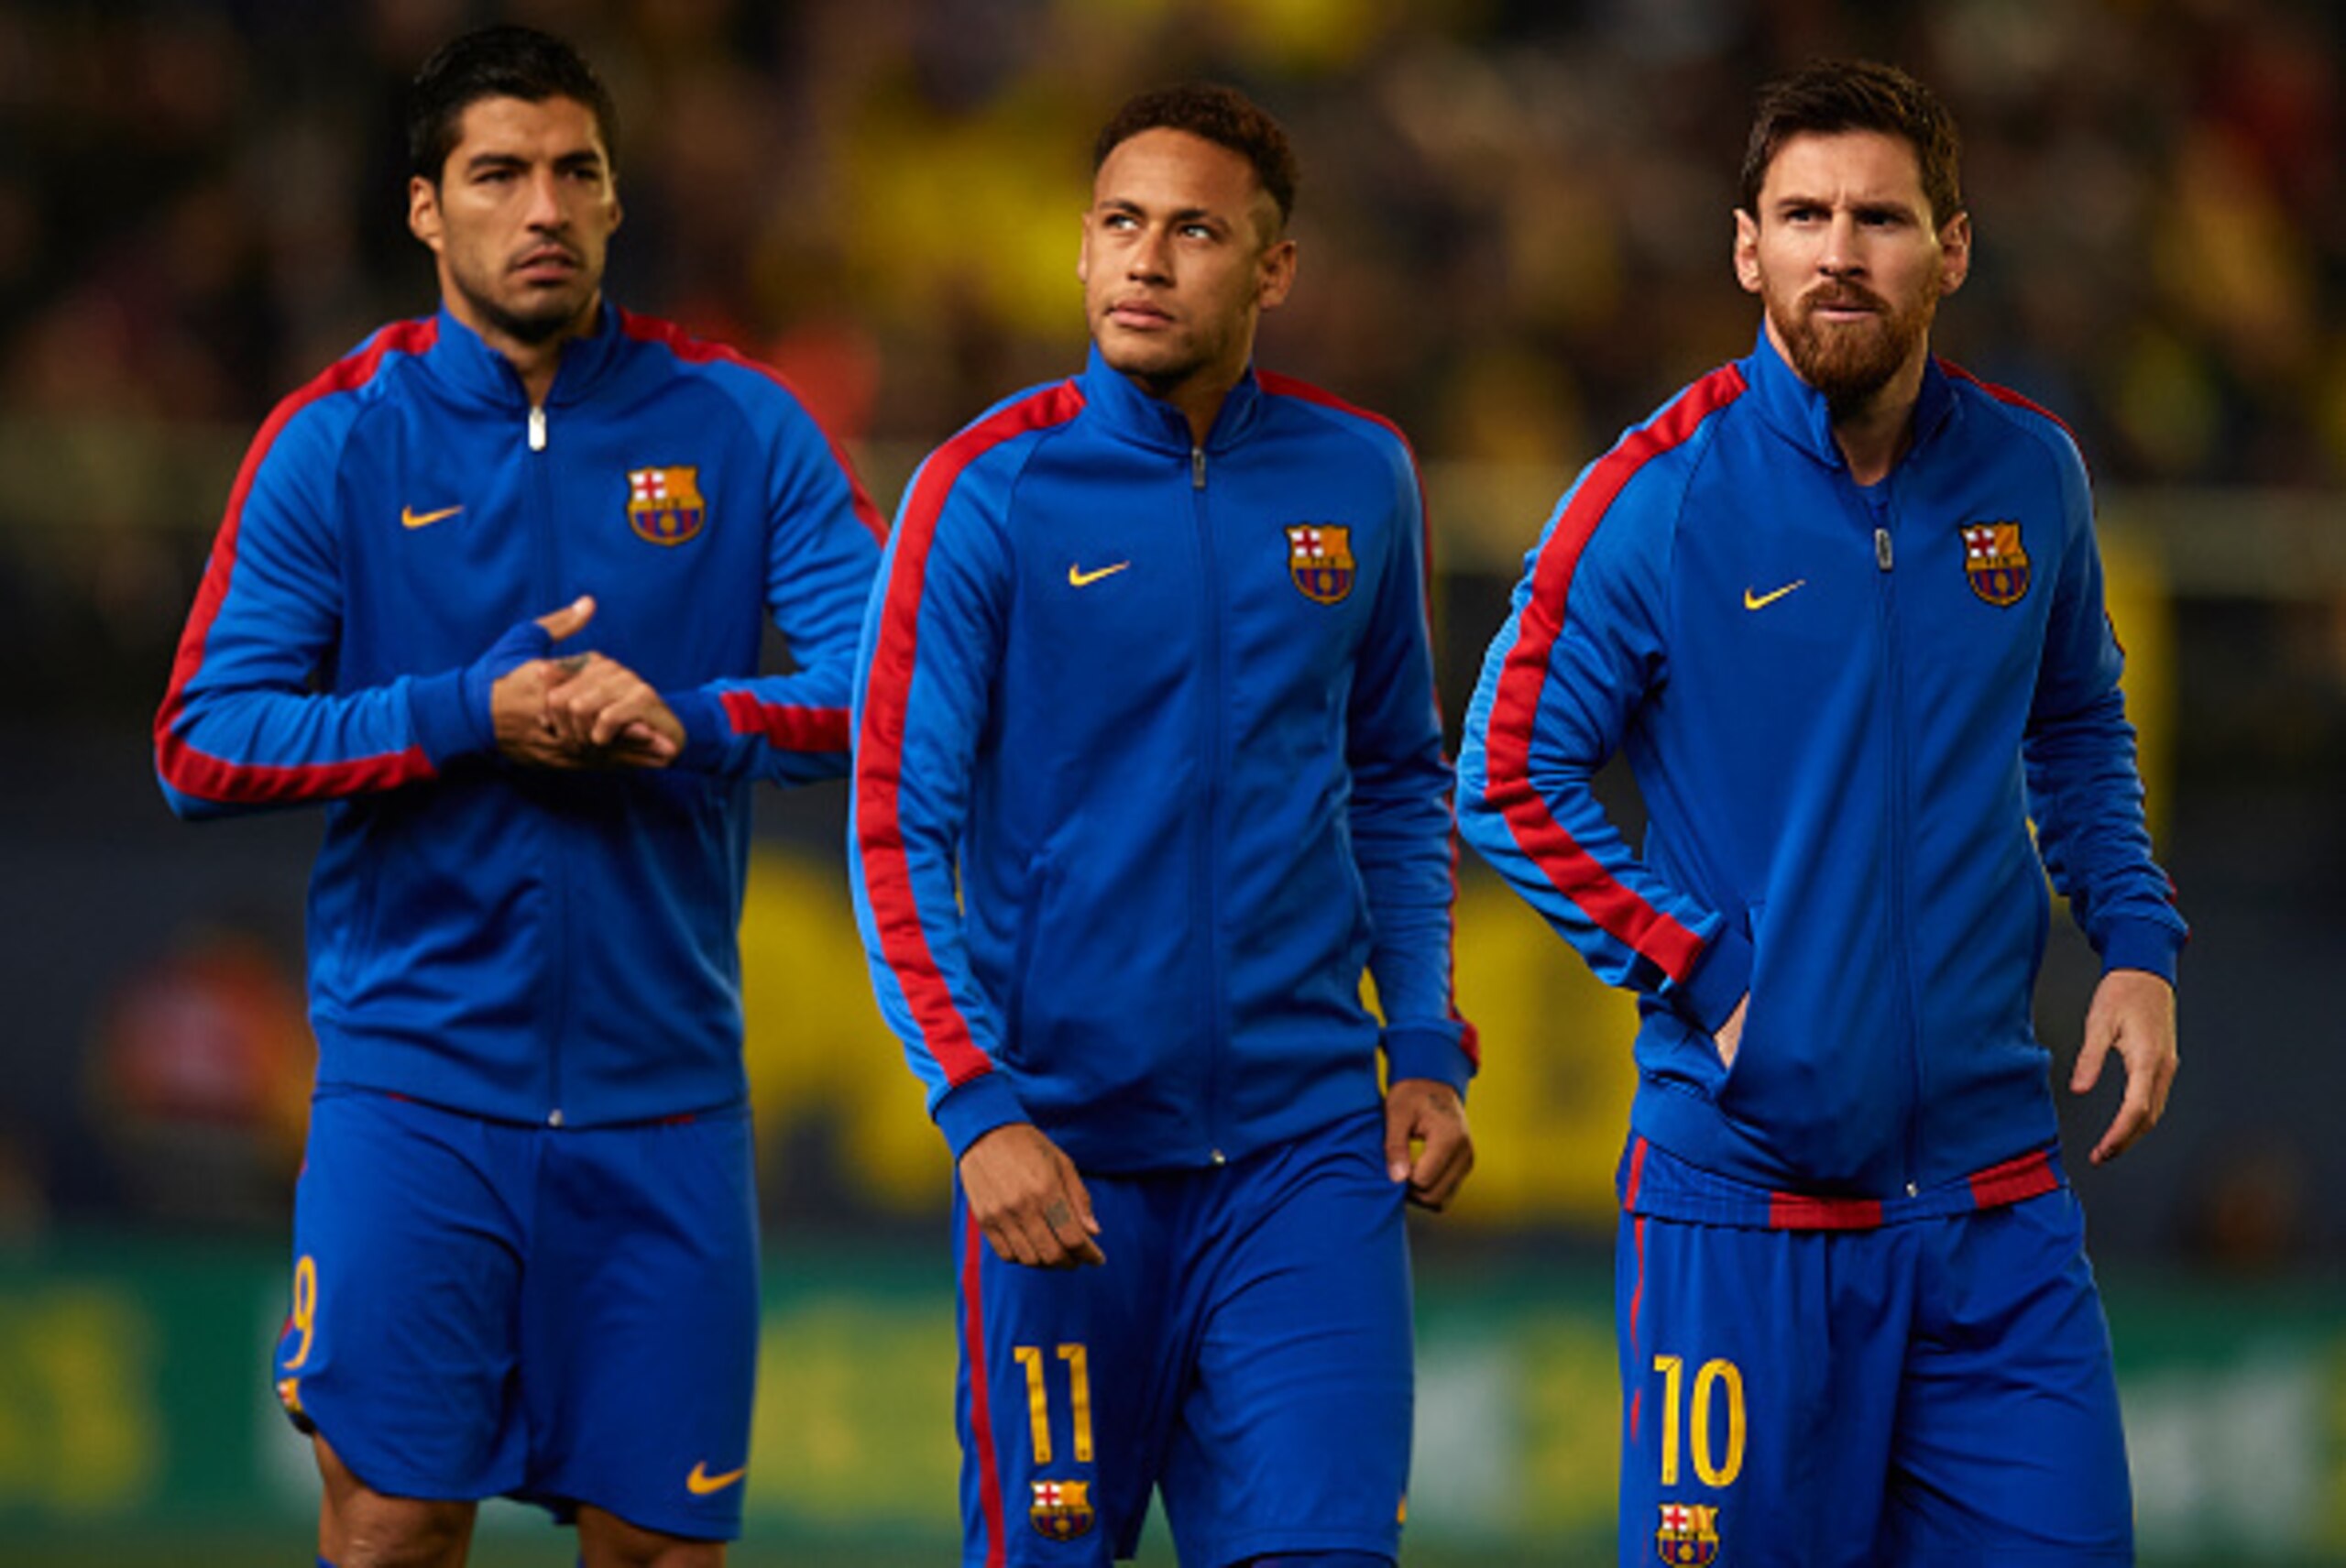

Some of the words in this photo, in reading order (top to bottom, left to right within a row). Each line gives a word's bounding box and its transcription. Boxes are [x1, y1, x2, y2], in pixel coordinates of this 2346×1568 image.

[283, 1255, 317, 1370] 9
[1014, 1343, 1094, 1464] 11
[1653, 1354, 1747, 1488] 10
